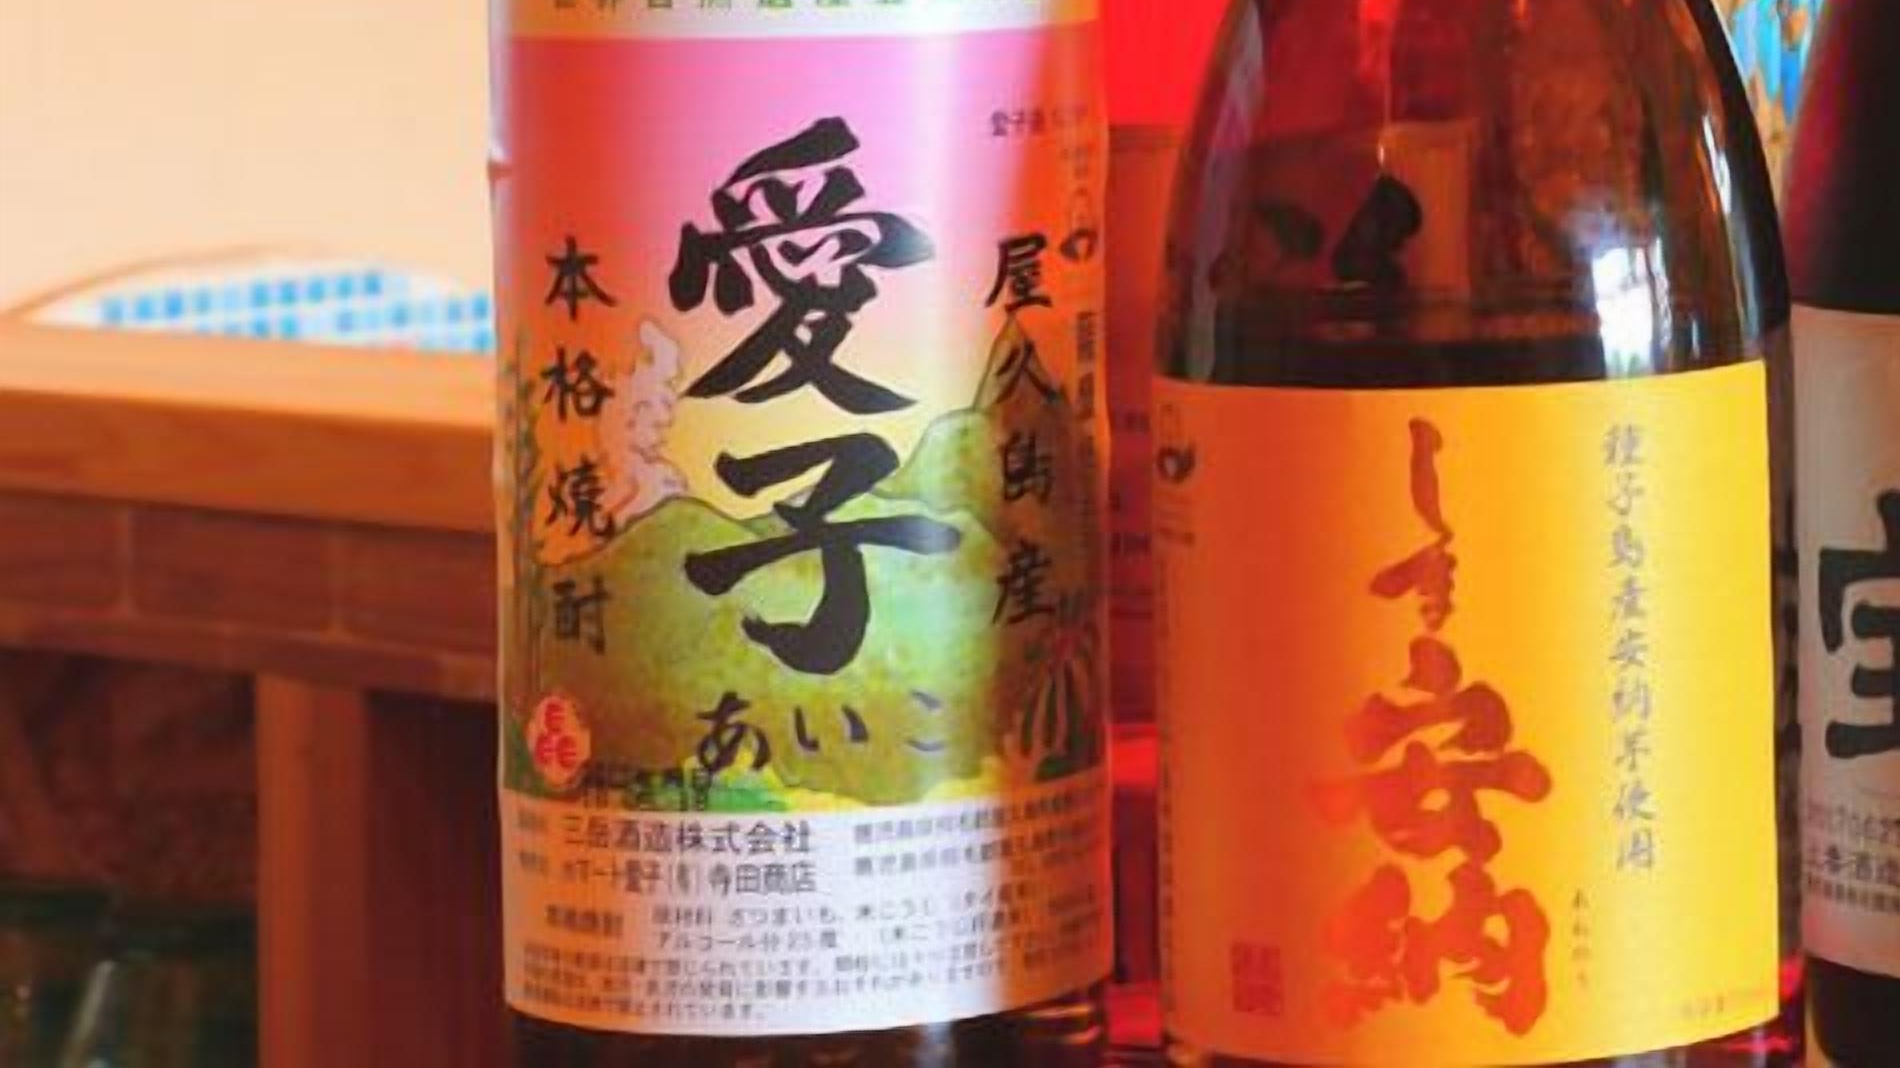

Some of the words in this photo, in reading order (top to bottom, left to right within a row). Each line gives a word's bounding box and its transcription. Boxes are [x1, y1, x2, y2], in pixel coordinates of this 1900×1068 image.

[544, 235, 617, 655] 本格焼酎
[669, 117, 962, 675] 愛子
[985, 236, 1068, 627] 屋久島産
[697, 692, 945, 772] あいこ
